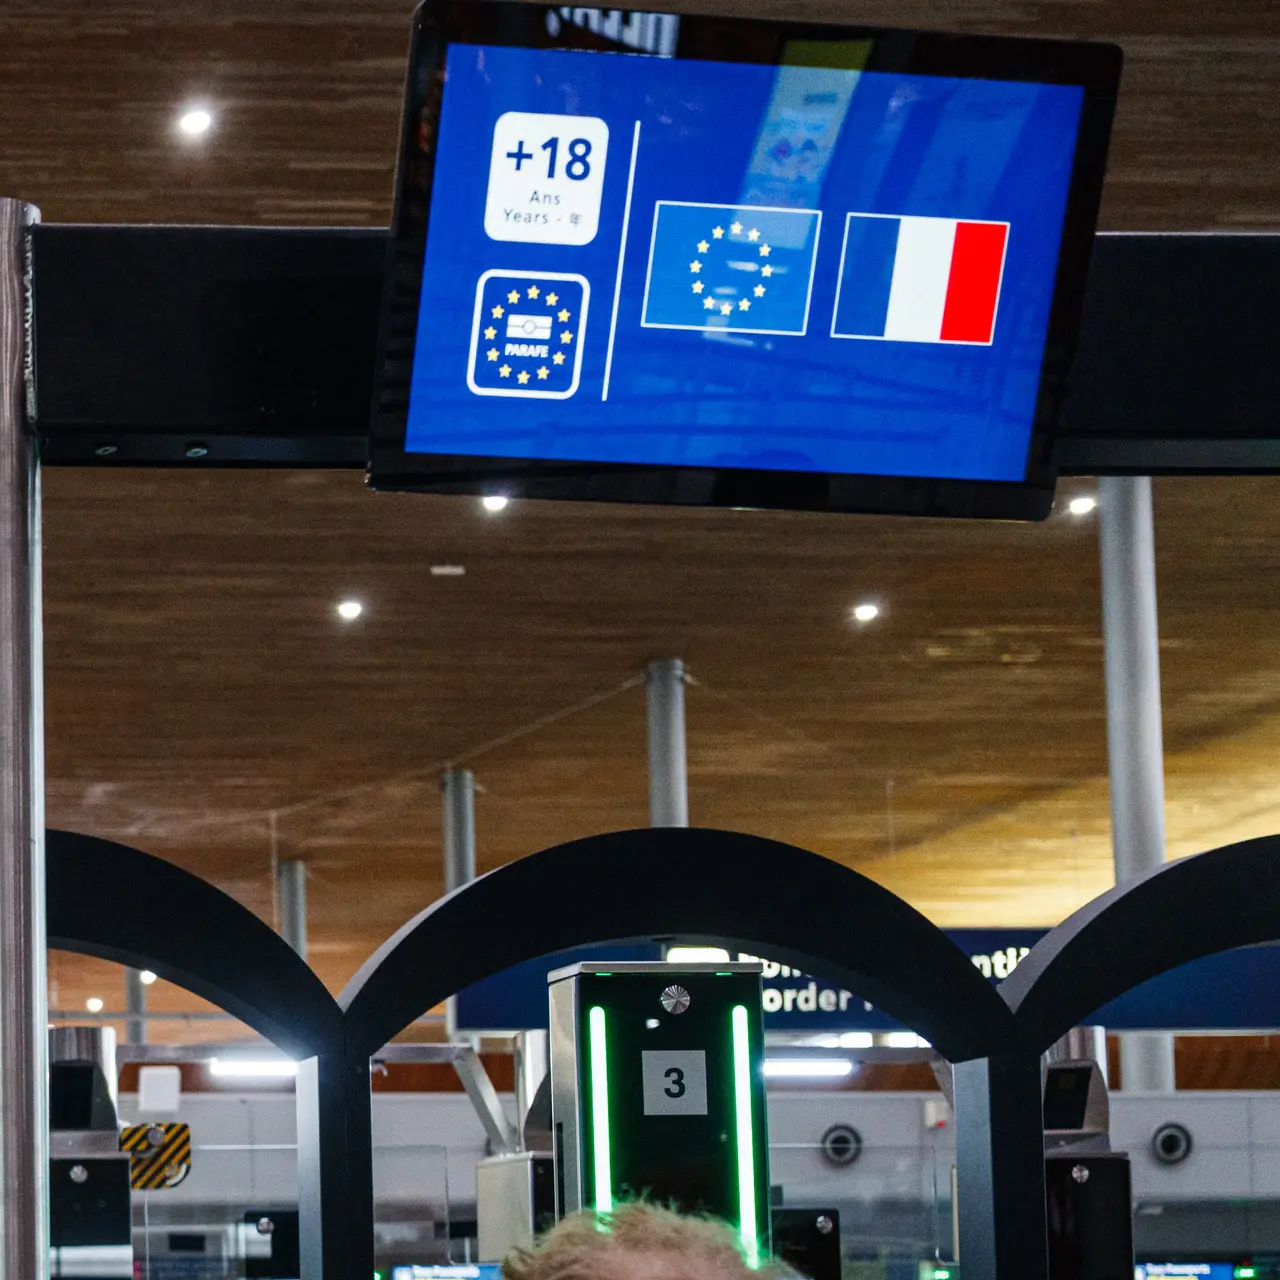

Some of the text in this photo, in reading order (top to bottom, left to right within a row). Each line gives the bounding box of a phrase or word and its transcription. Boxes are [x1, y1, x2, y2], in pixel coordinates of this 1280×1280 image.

[506, 136, 592, 181] +18
[529, 190, 561, 206] Ans
[503, 208, 549, 224] Years
[504, 342, 549, 358] PARAFE
[763, 982, 853, 1012] order
[663, 1067, 685, 1098] 3
